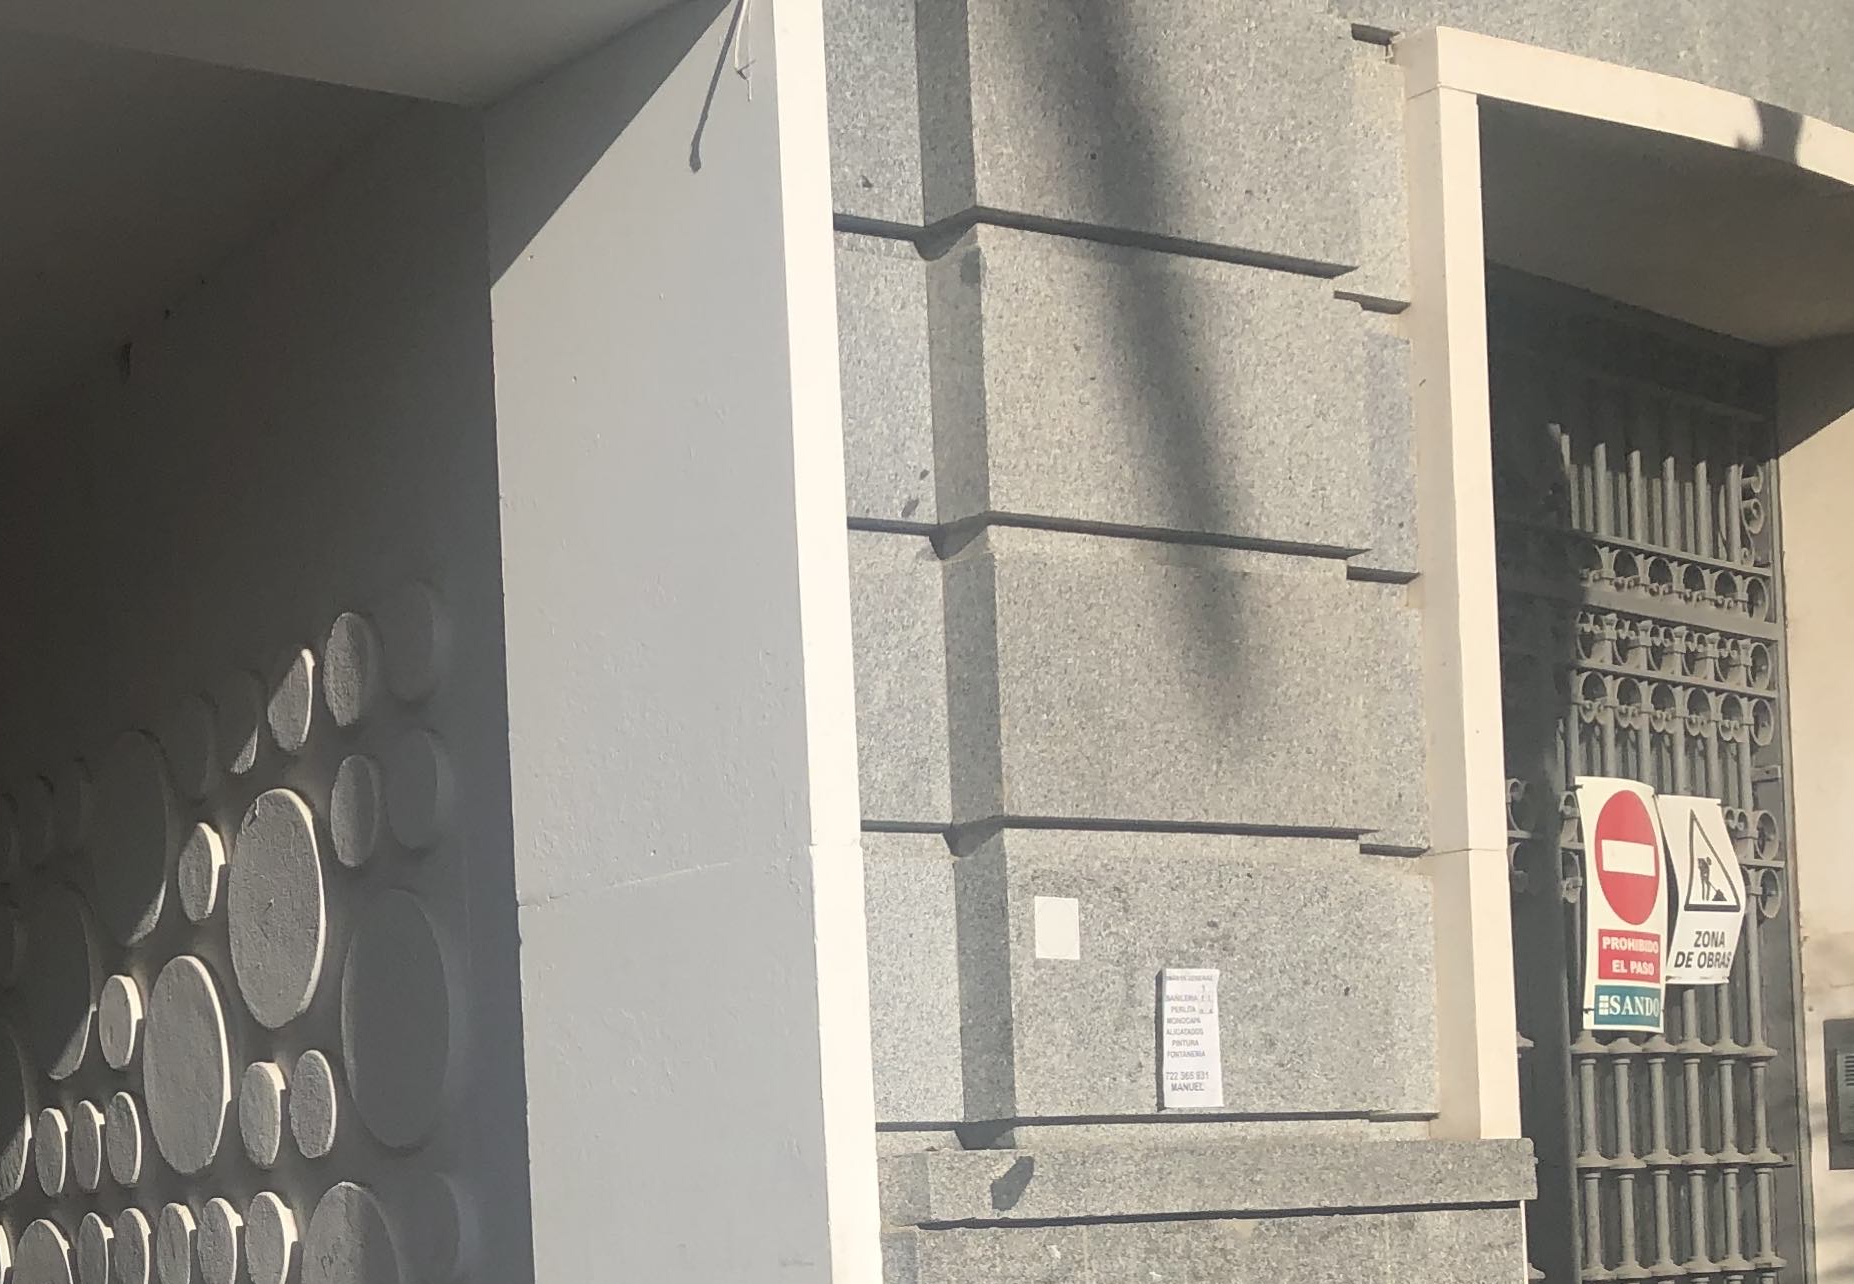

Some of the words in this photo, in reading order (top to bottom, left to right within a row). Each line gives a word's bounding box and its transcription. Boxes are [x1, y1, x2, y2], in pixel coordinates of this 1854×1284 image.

[1602, 936, 1659, 954] PROHIBIDO
[1694, 931, 1726, 948] ZONA
[1612, 959, 1627, 974] EL
[1630, 960, 1654, 976] PASO
[1674, 951, 1694, 968] DE
[1697, 951, 1732, 968] OBRAS
[1609, 995, 1660, 1017] SANDO
[1172, 1039, 1199, 1047] PINTURA
[1166, 1071, 1178, 1081] 722
[1171, 1082, 1205, 1091] MANUEL
